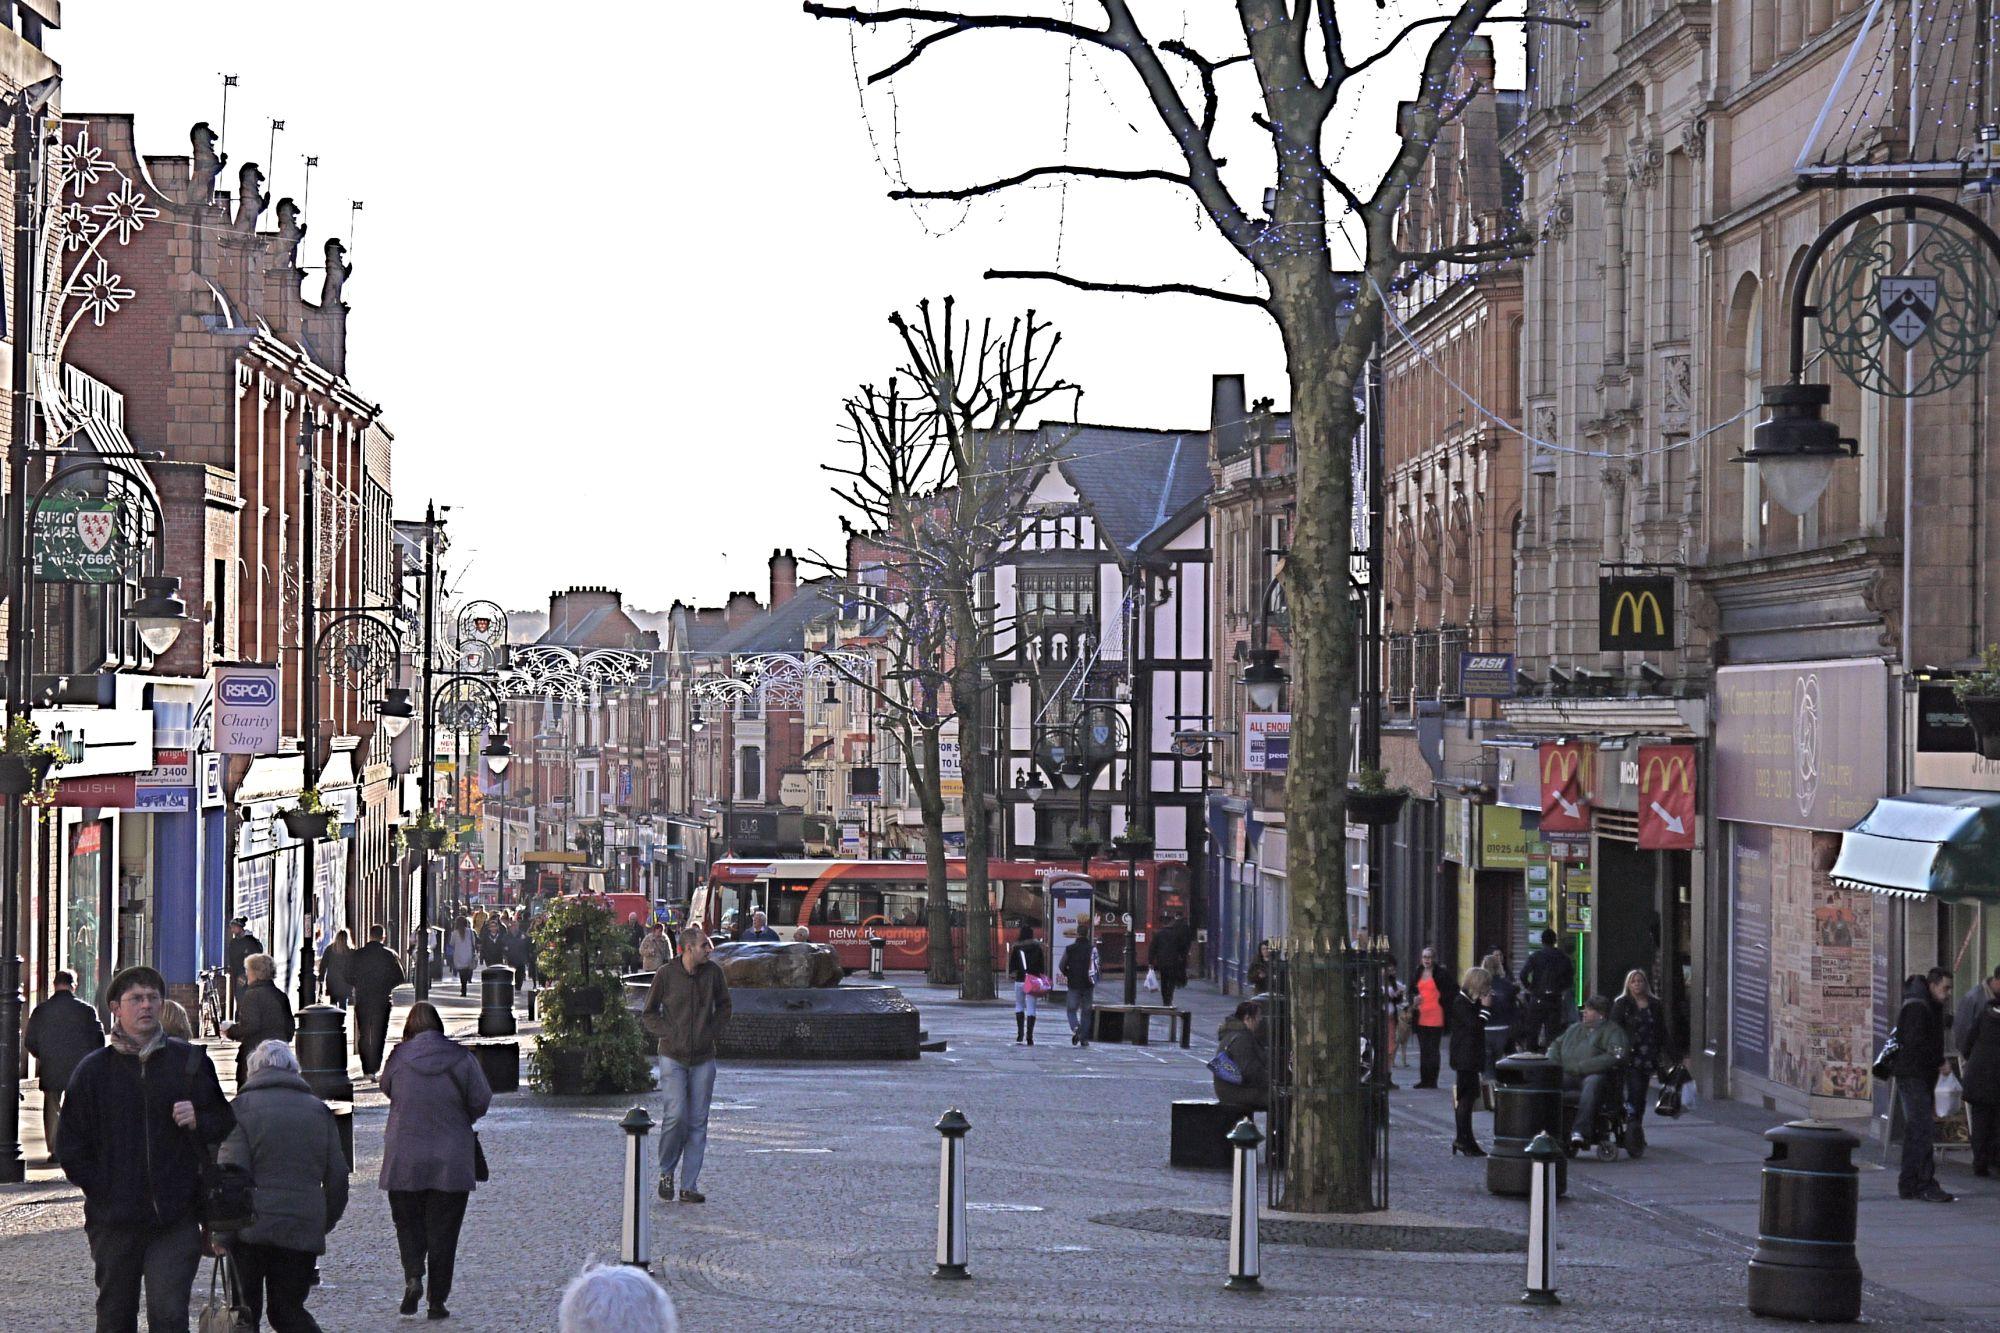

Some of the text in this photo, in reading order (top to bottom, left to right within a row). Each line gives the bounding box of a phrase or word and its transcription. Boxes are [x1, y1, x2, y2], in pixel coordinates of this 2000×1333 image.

[1469, 658, 1506, 669] CASH
[225, 684, 269, 698] RSPCA
[221, 713, 272, 730] Charity
[1250, 722, 1264, 732] ALL
[229, 732, 263, 749] Shop
[942, 759, 952, 767] TO
[162, 767, 187, 776] 3400
[1120, 868, 1145, 877] mve
